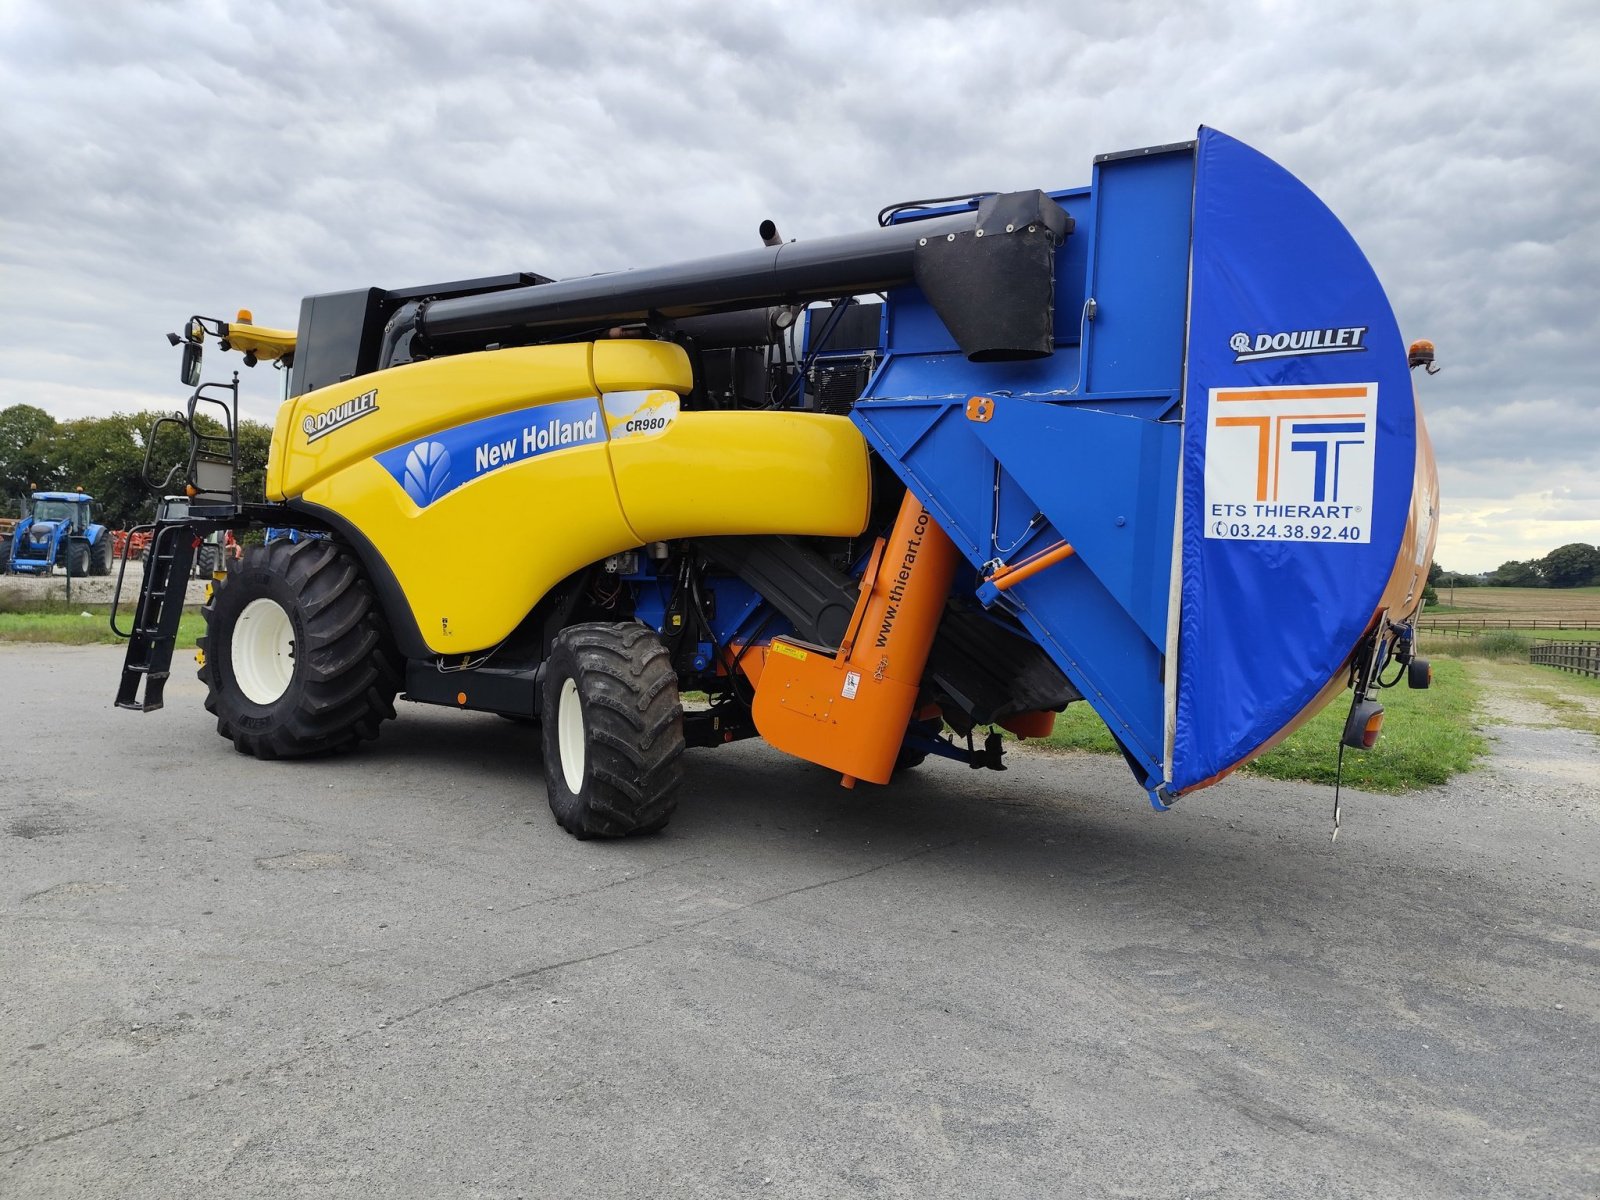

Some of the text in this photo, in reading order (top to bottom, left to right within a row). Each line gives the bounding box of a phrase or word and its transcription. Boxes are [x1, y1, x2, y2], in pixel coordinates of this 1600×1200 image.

[1254, 327, 1366, 352] DOUILLET
[316, 389, 378, 430] DOUILLET
[625, 417, 665, 432] CR980
[475, 411, 597, 473] New Holland
[1211, 503, 1353, 519] ETS THIERART
[1229, 523, 1361, 541] 03.24.38.92.40
